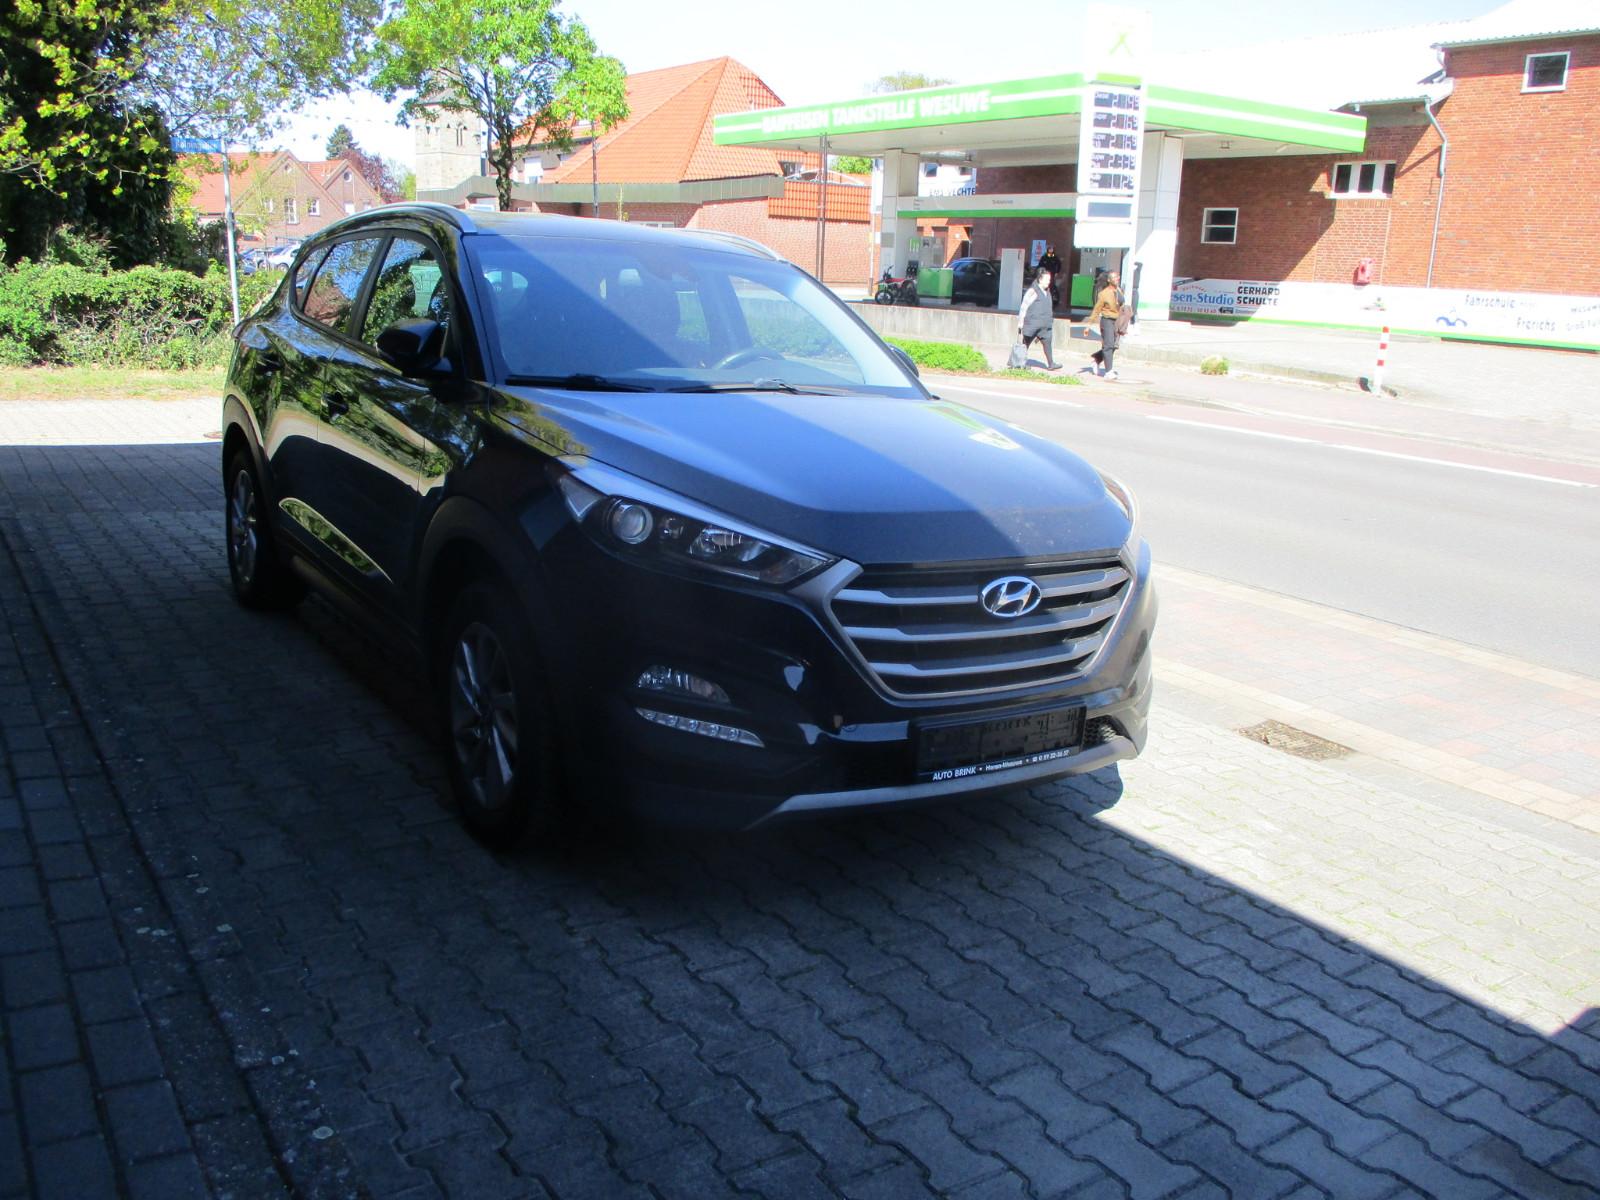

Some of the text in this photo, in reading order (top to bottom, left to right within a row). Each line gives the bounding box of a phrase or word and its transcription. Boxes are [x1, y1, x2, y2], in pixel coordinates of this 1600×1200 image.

[1237, 286, 1280, 296] GERHARD
[1236, 296, 1278, 306] SCHULTE
[932, 770, 952, 782] AUTO
[954, 766, 977, 778] BRINK
